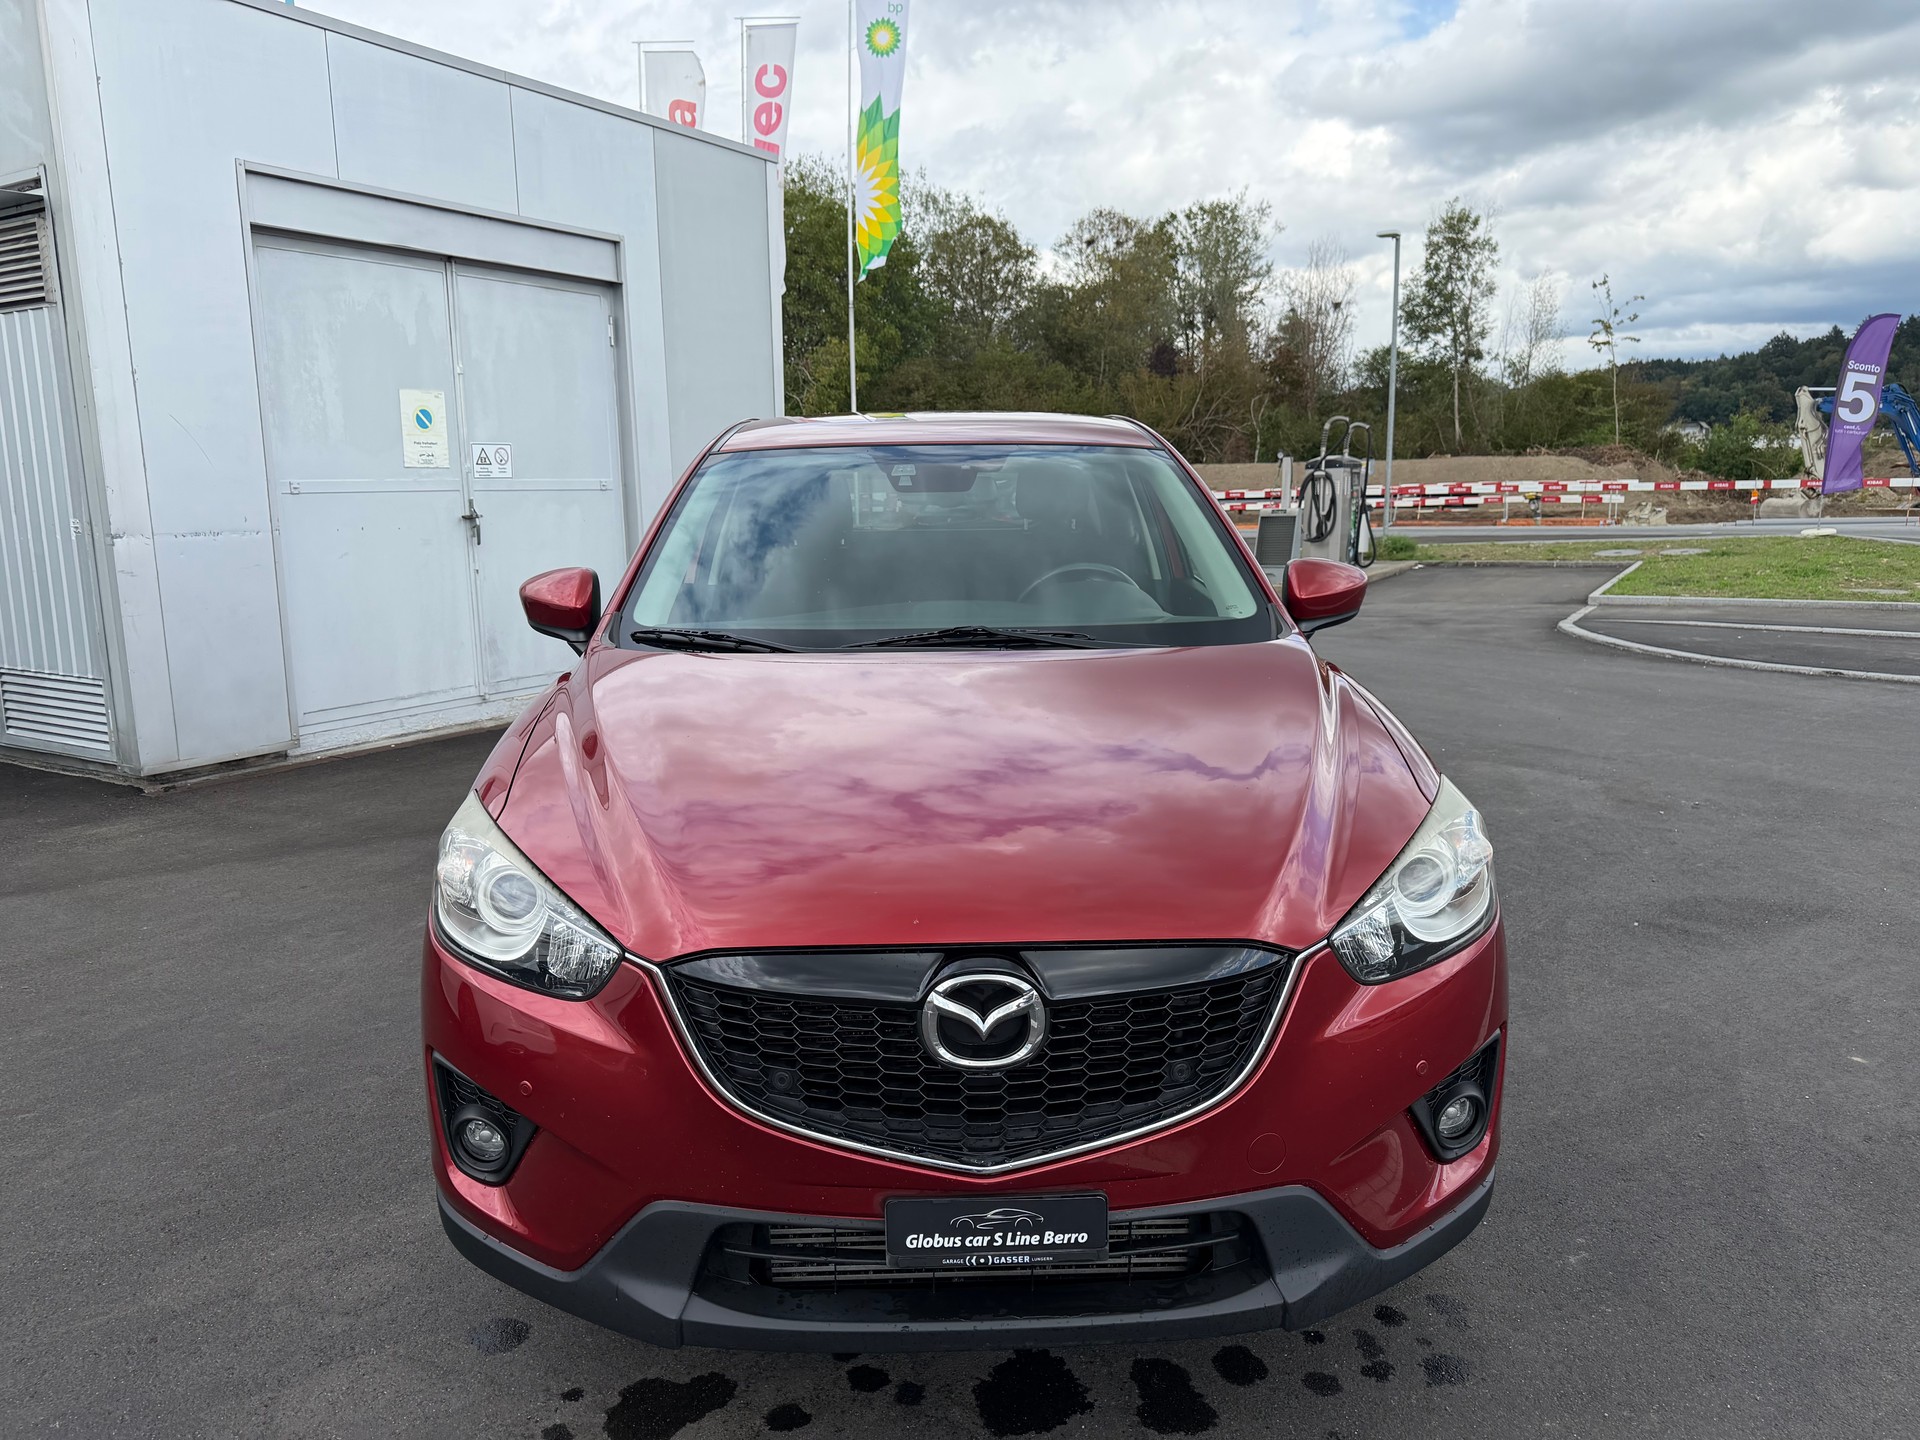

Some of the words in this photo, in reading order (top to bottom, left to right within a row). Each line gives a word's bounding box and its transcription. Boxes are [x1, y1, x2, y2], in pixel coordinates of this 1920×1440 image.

[887, 1, 904, 16] bp
[1847, 360, 1881, 374] Sconto
[1837, 371, 1878, 423] 5
[905, 1233, 962, 1249] Globus
[964, 1236, 990, 1247] car
[992, 1232, 1004, 1246] S
[1006, 1231, 1040, 1246] Line
[1043, 1230, 1089, 1245] Berro
[993, 1255, 1030, 1264] GASSER
